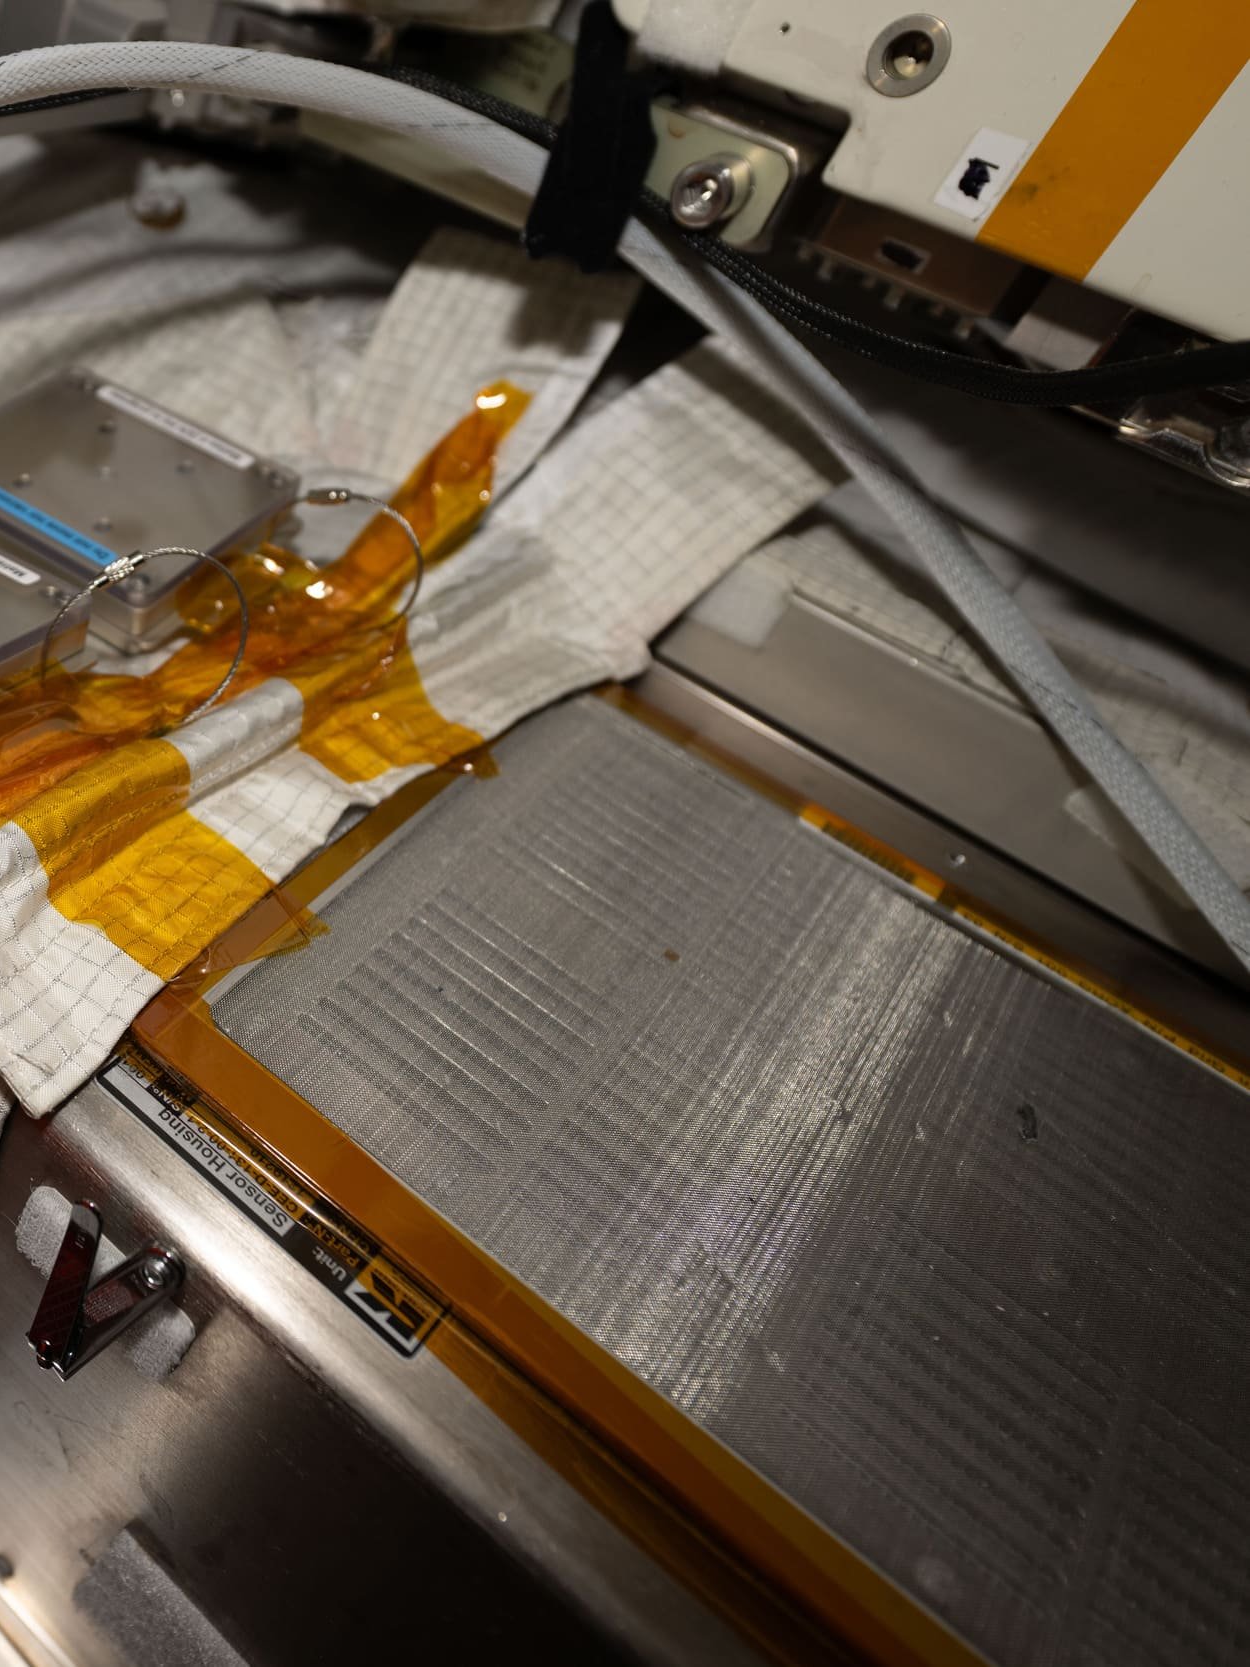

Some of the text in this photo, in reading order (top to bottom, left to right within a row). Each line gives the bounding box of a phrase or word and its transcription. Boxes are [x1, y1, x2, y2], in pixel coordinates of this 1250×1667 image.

[157, 1108, 348, 1282] Unit: Sensor Housing
